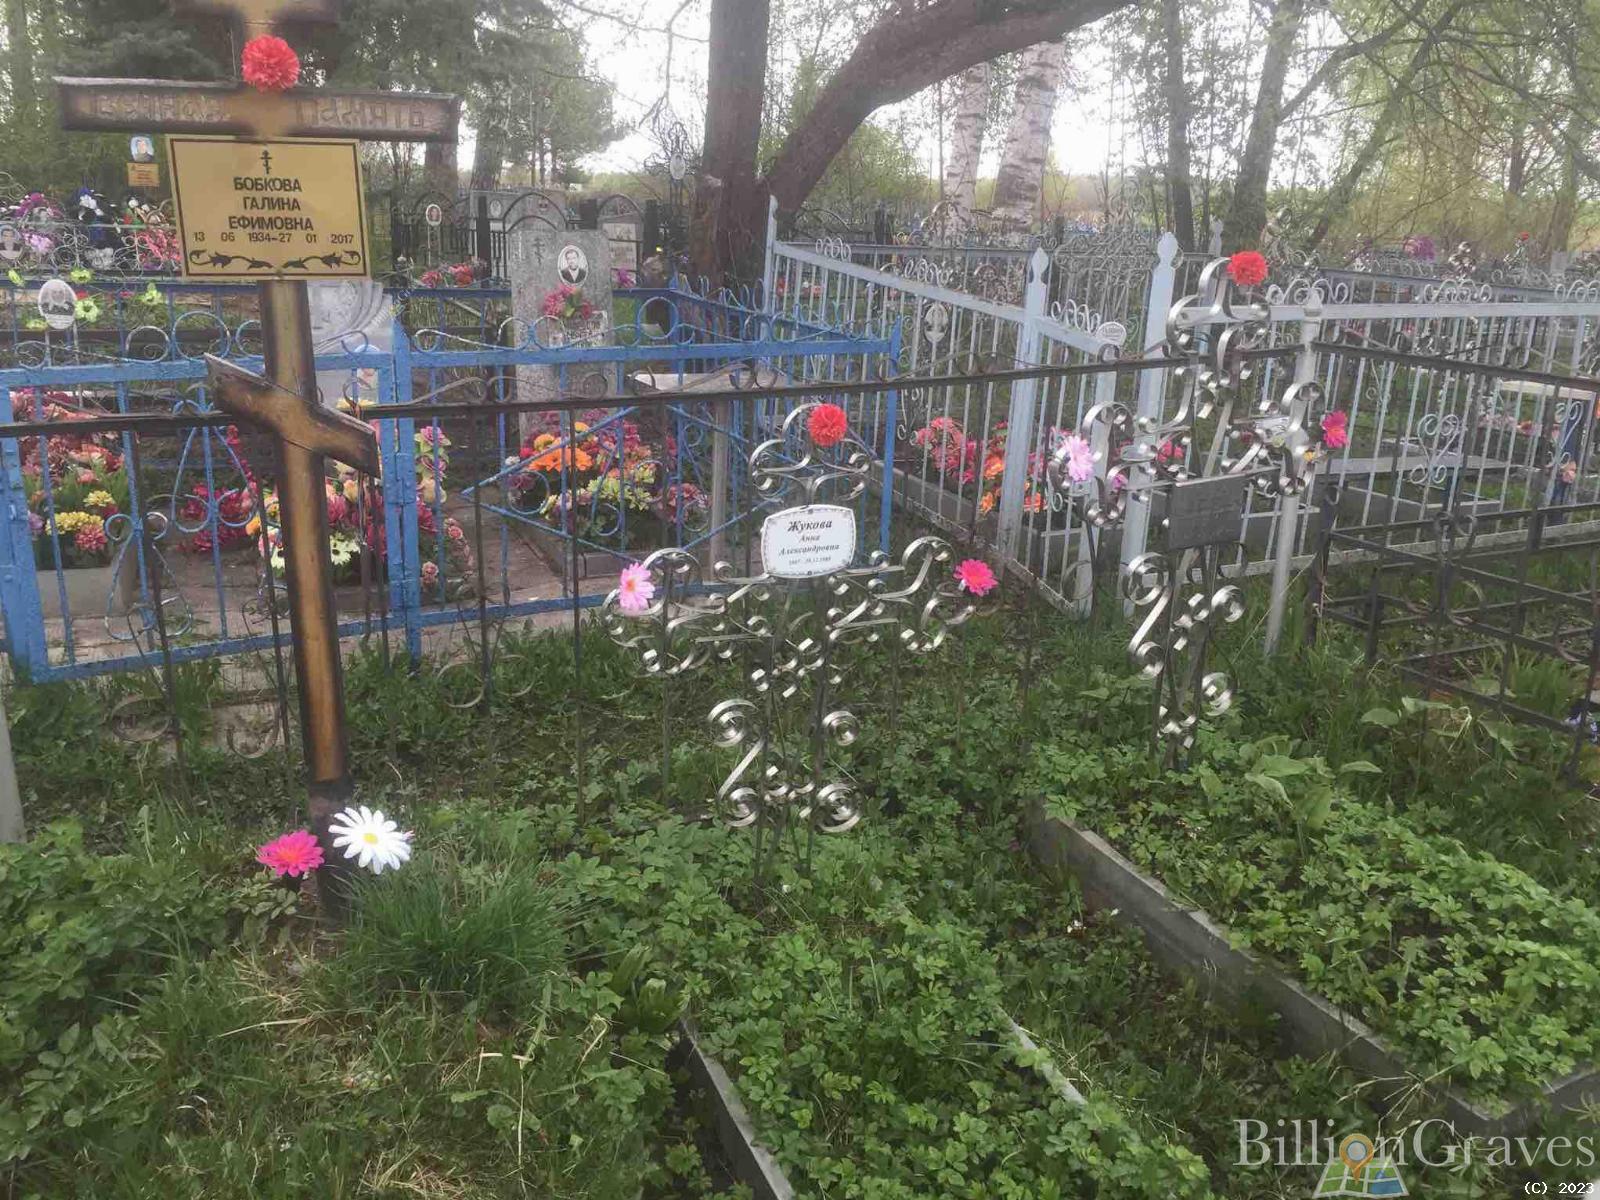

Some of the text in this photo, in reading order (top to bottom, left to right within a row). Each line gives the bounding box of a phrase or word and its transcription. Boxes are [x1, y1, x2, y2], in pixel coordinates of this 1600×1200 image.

[233, 177, 303, 192] БОБКОВА
[243, 196, 301, 211] ГАЛИНА
[228, 216, 314, 231] ЕФИМОВНА
[194, 232, 205, 242] 13
[221, 232, 235, 242] 06
[305, 233, 317, 243] 01
[331, 234, 354, 244] 2017
[788, 520, 832, 533] Жукова
[799, 535, 821, 543] Анна
[779, 544, 840, 556] Александровна
